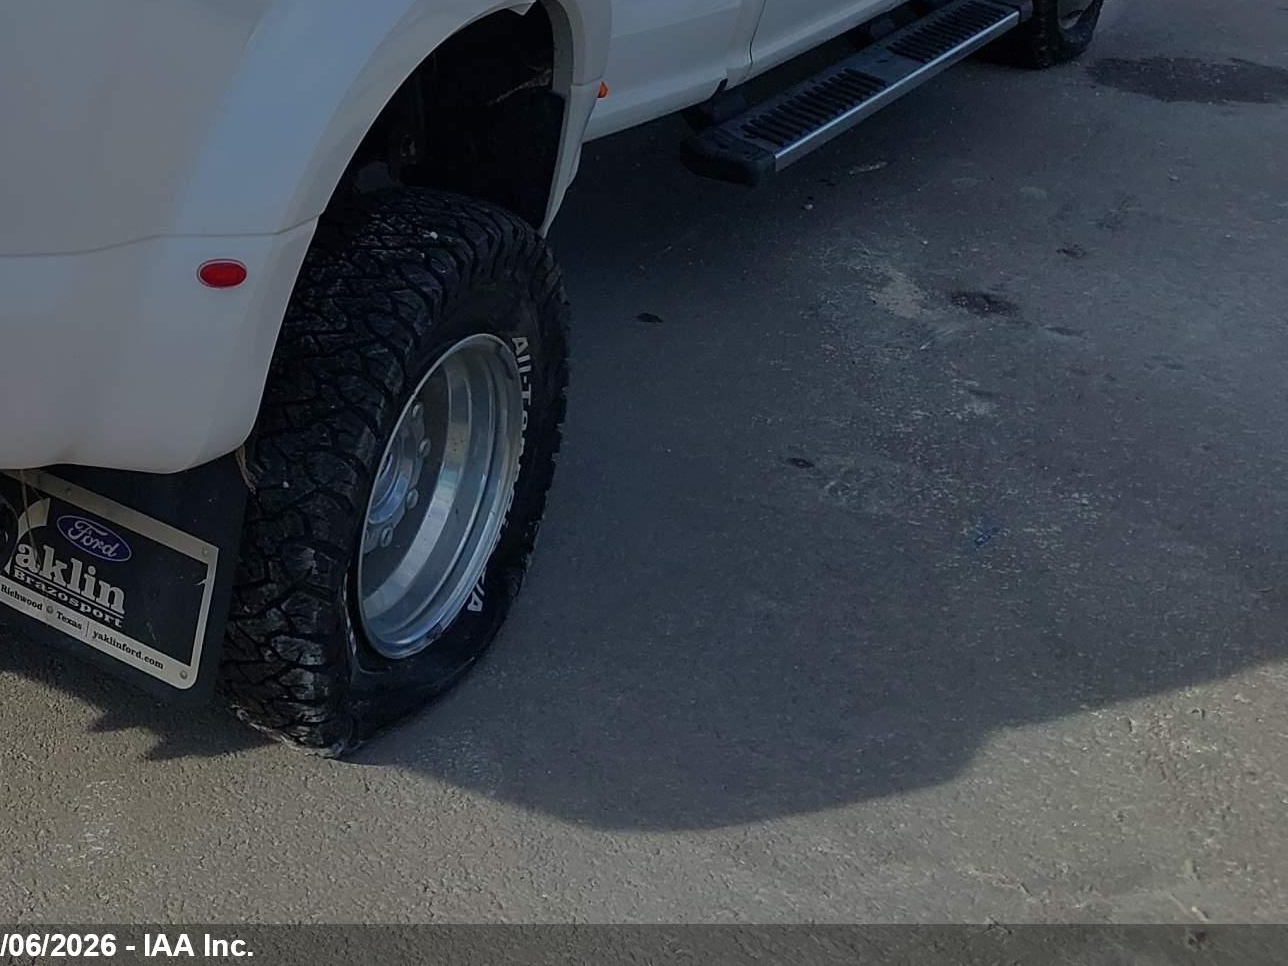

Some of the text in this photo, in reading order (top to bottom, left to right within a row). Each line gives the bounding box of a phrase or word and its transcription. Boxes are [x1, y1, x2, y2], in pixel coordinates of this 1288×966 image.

[68, 520, 120, 557] Ford
[11, 537, 125, 614] aklin
[14, 569, 123, 628] Brazosport
[0, 584, 83, 630] Richwood Texas
[92, 630, 164, 670] yaklinford.com
